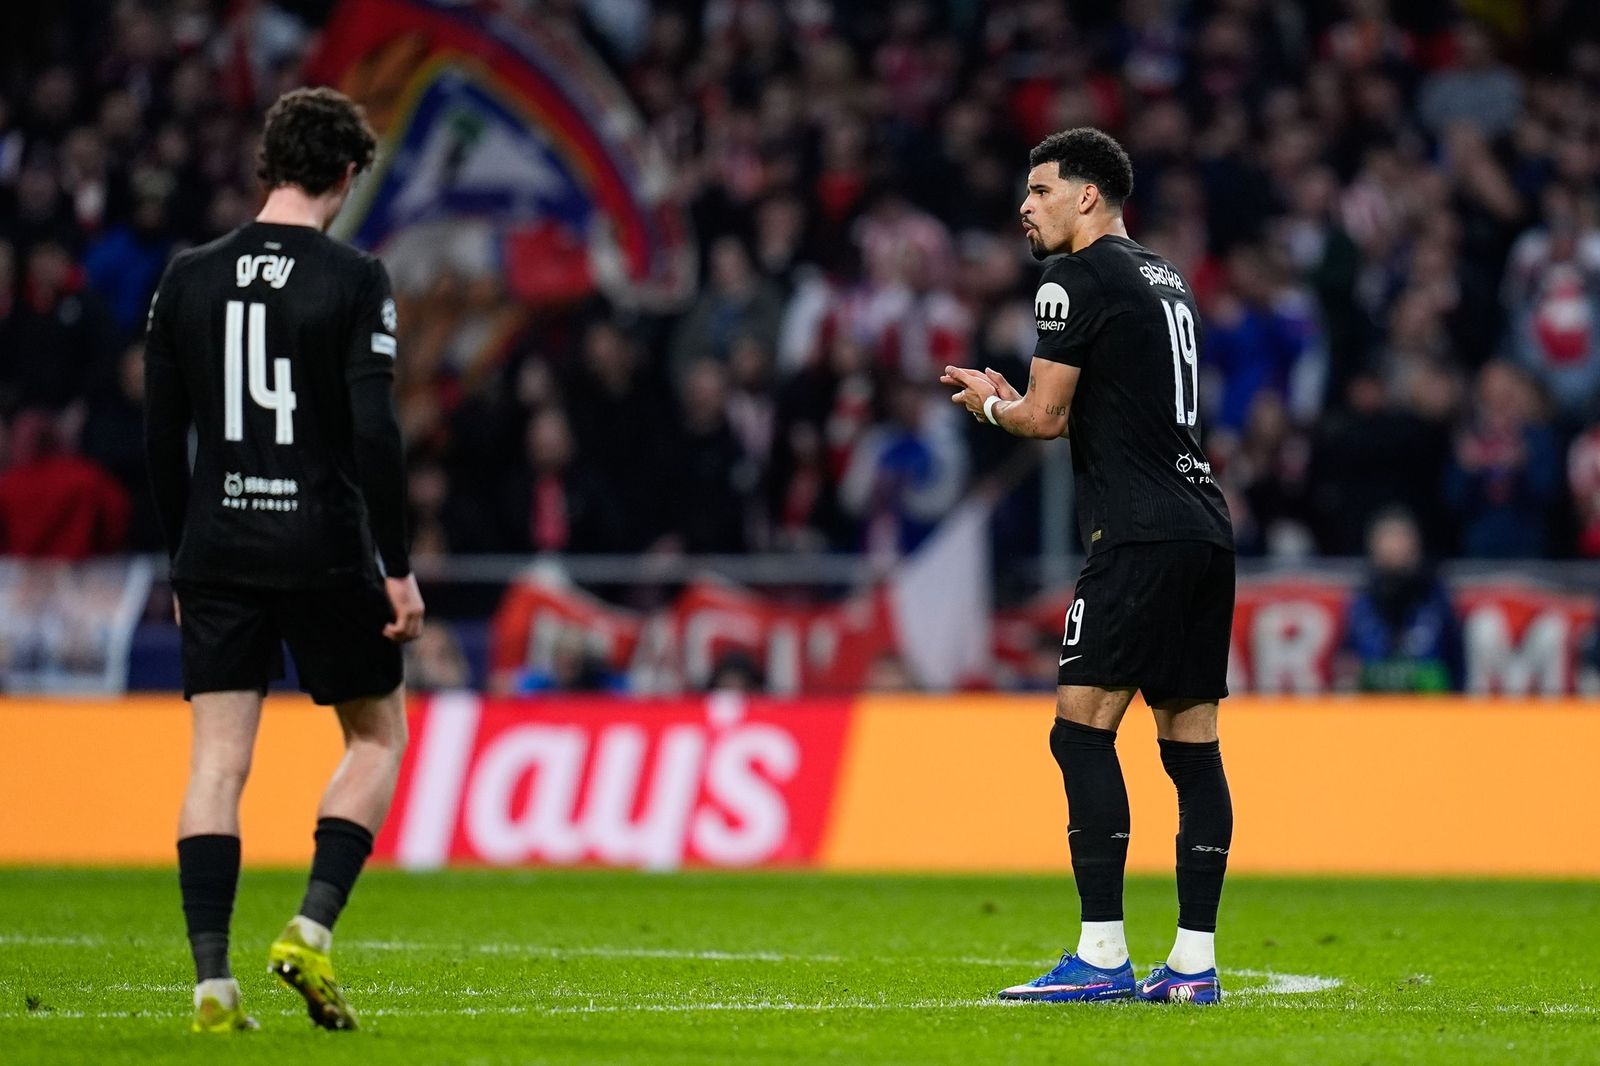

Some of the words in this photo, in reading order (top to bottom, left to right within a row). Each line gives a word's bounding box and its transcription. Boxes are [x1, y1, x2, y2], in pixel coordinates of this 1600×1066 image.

[236, 254, 296, 289] gray
[1139, 261, 1186, 293] solanke
[1037, 320, 1066, 331] raken
[224, 300, 297, 445] 14
[1160, 298, 1199, 426] 19
[1062, 598, 1085, 646] 19
